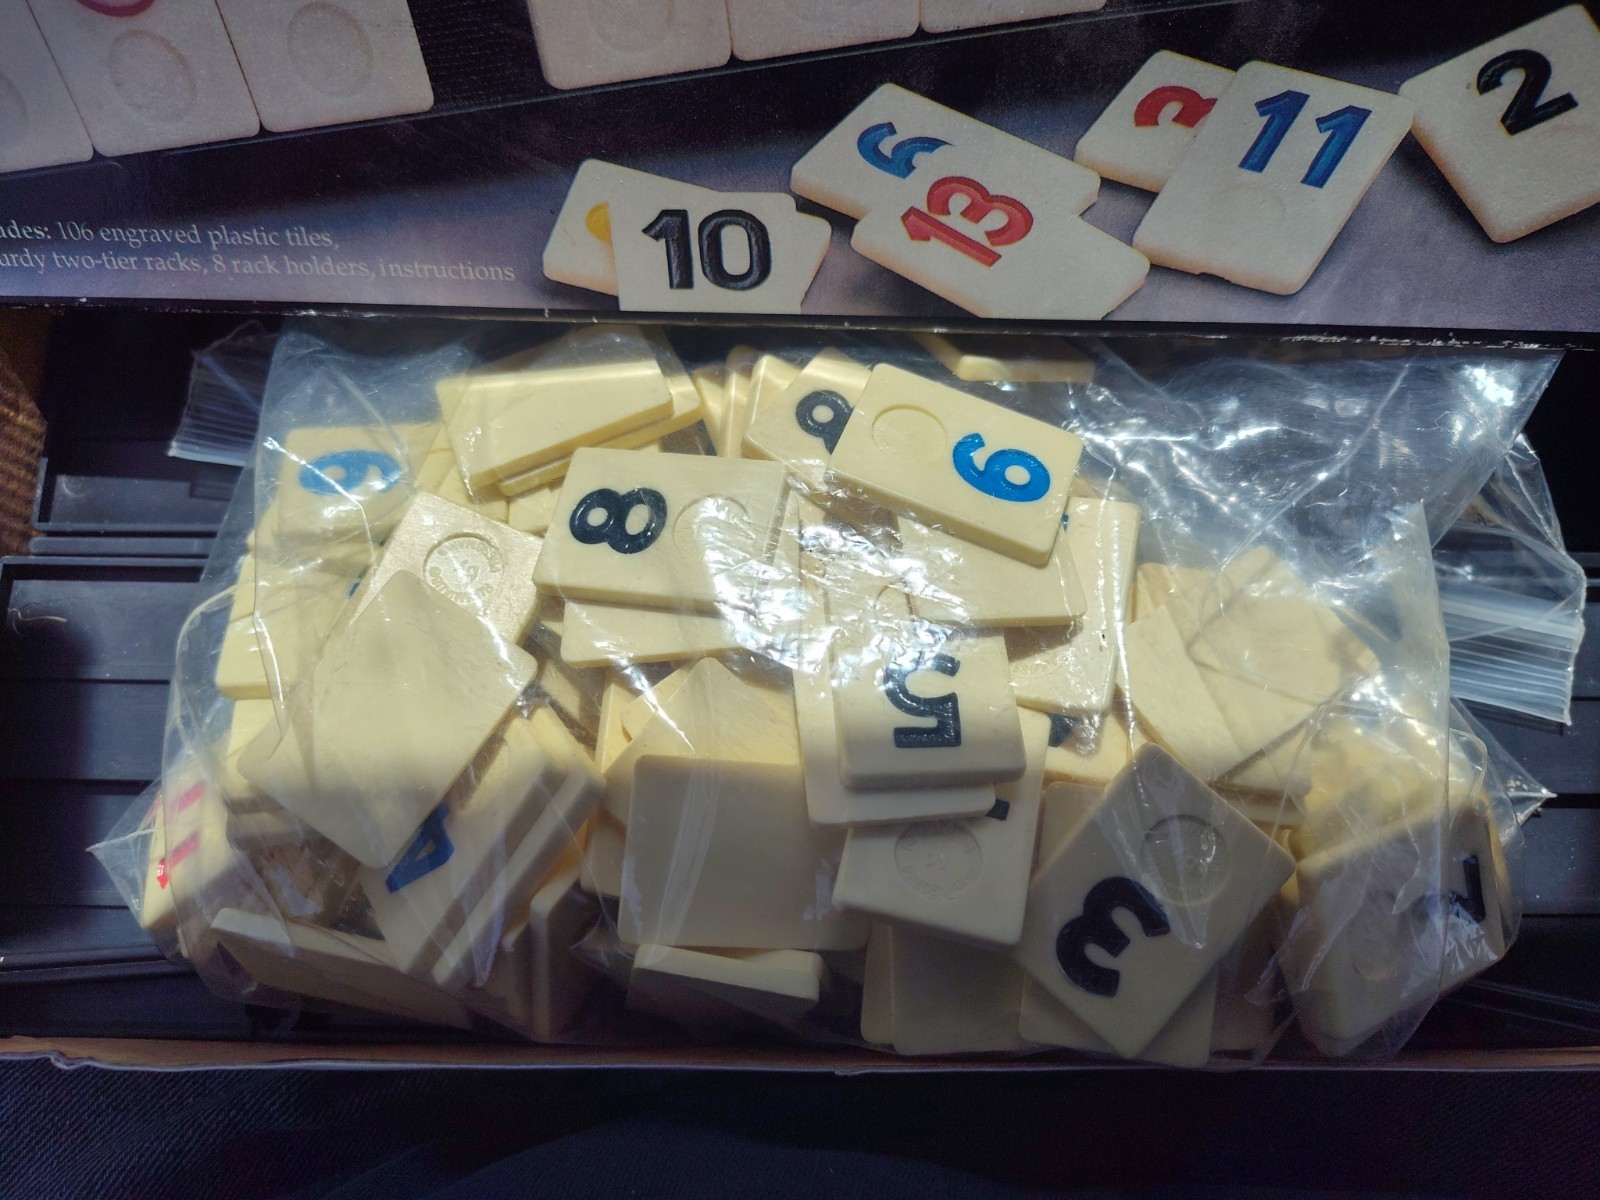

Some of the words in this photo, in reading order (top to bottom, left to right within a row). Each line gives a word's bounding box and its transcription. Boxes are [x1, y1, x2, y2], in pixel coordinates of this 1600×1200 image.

[1477, 49, 1578, 136] 2
[1238, 89, 1372, 189] 11
[58, 221, 94, 241] 106
[100, 224, 202, 249] engraved
[207, 225, 280, 251] plastic
[287, 226, 340, 250] tiles,
[641, 208, 773, 291] 10
[900, 175, 1034, 268] 13
[53, 250, 137, 270] two-tier
[146, 252, 208, 276] racks,
[213, 254, 226, 272] 8
[234, 255, 280, 274] rack
[284, 256, 376, 280] holders,
[381, 259, 516, 283] instructions
[569, 487, 667, 554] 8
[883, 650, 961, 748] 5
[1056, 876, 1170, 997] 3
